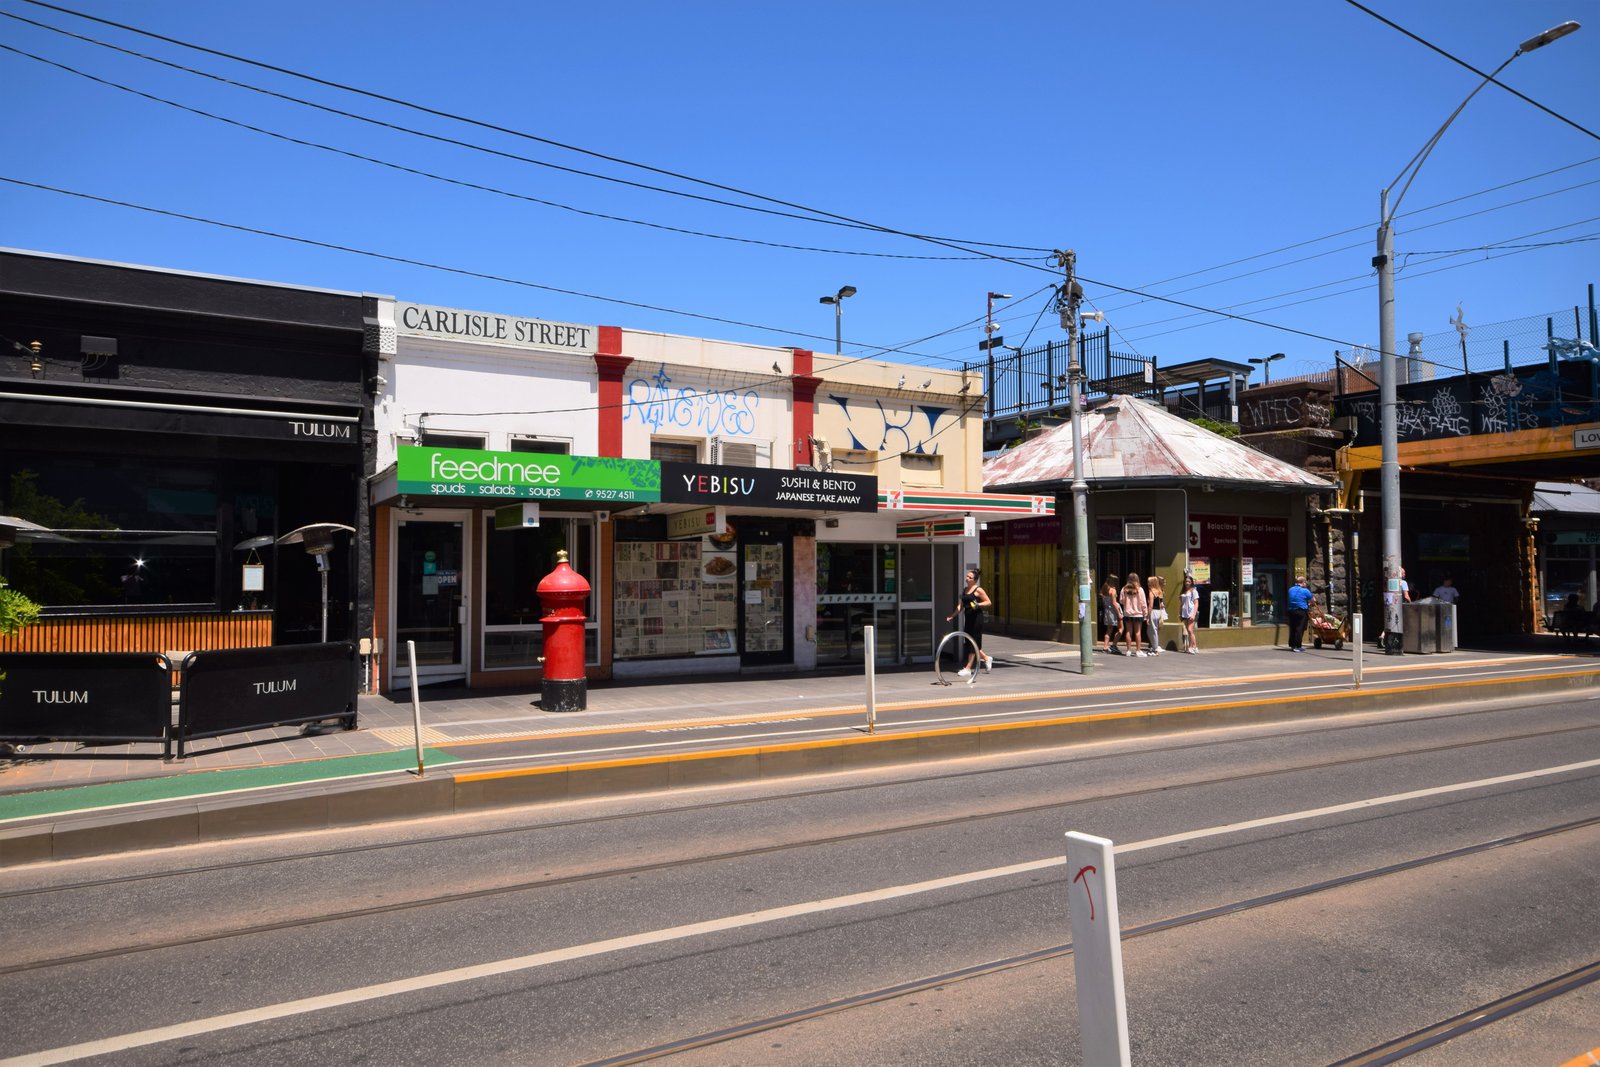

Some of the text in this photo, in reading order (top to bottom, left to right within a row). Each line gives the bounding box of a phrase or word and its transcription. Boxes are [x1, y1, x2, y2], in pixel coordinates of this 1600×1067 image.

[403, 306, 590, 349] CARLISLE STREET
[288, 420, 351, 439] TULUM
[431, 453, 561, 484] feedmee
[431, 483, 561, 499] spuds salads soups
[683, 475, 755, 495] YEBISU
[781, 476, 856, 491] SUSHI & BENTO
[596, 489, 635, 500] 9527 4511
[775, 491, 861, 504] JAPANESE TAKE AWAY
[673, 517, 701, 530] YEBISU
[1207, 522, 1285, 533] Balaclava Optical Service
[437, 575, 457, 584] OPEN
[252, 678, 297, 695] TULUM
[32, 689, 89, 704] TULUM
